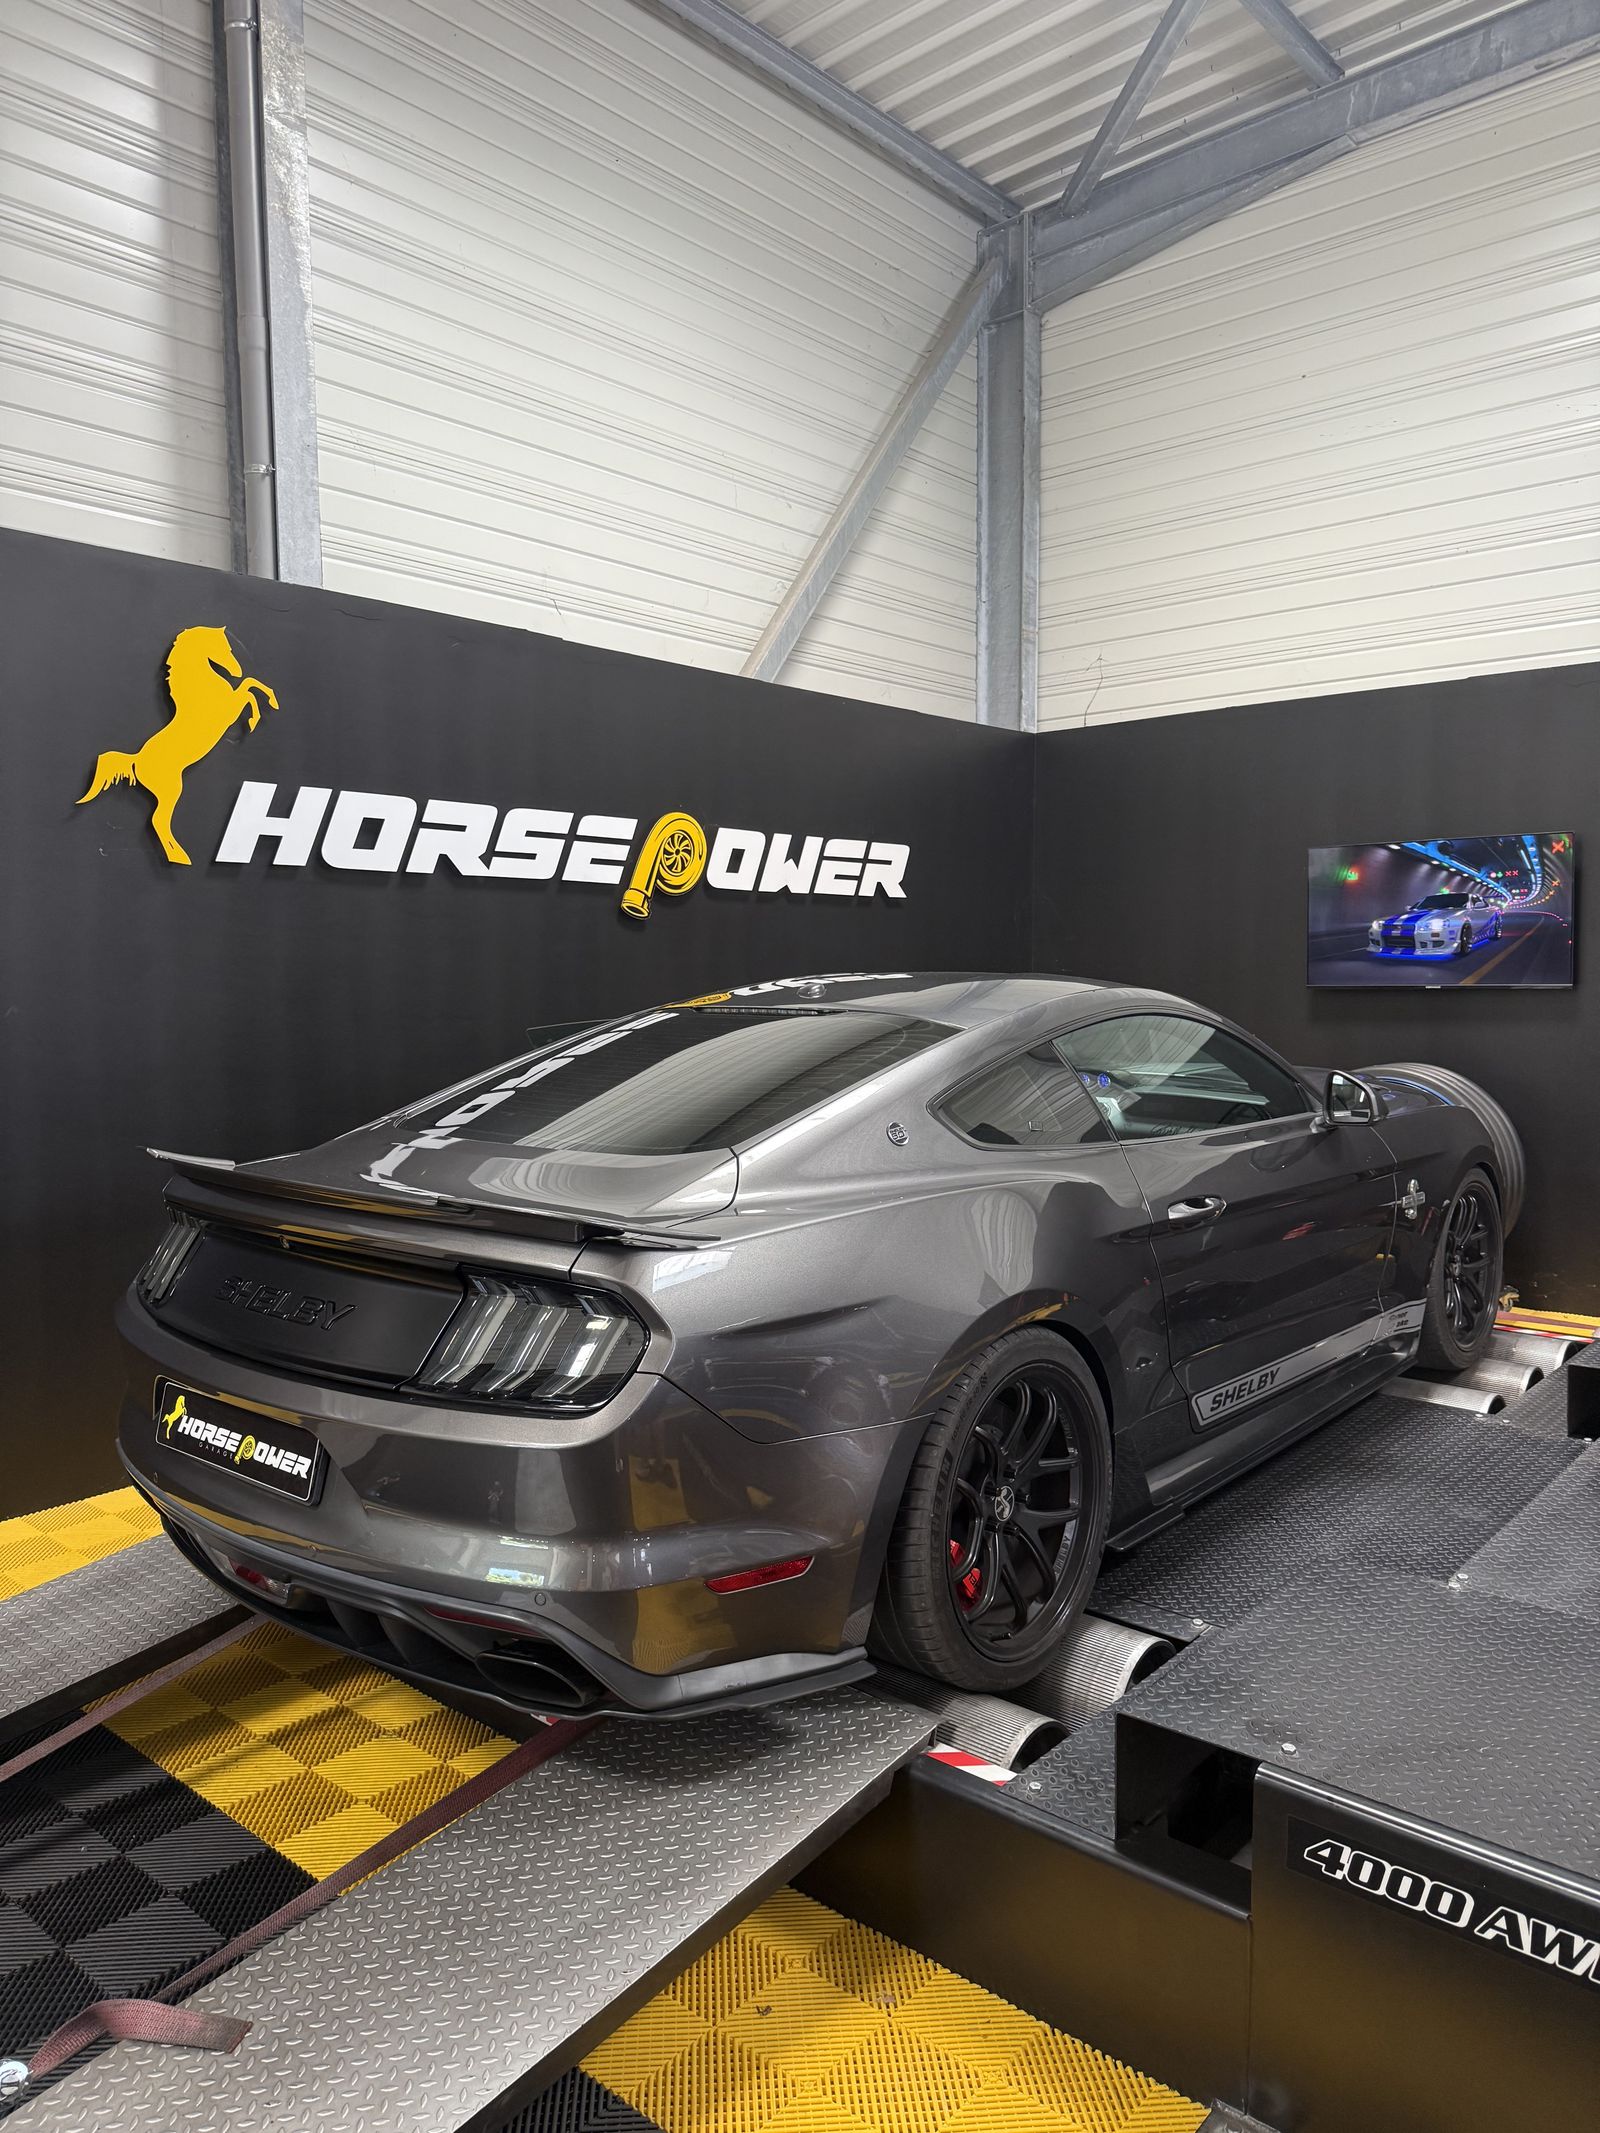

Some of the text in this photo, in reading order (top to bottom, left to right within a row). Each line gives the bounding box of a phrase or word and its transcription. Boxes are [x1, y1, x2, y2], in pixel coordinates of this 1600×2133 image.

[215, 781, 911, 920] HORSEPOWER
[214, 1275, 358, 1331] SHELBY
[1210, 1367, 1281, 1413] SHELBY
[177, 1415, 312, 1480] HORSEPOWER
[198, 1441, 235, 1460] GARAGE
[1303, 1838, 1600, 1985] 4000 AW
